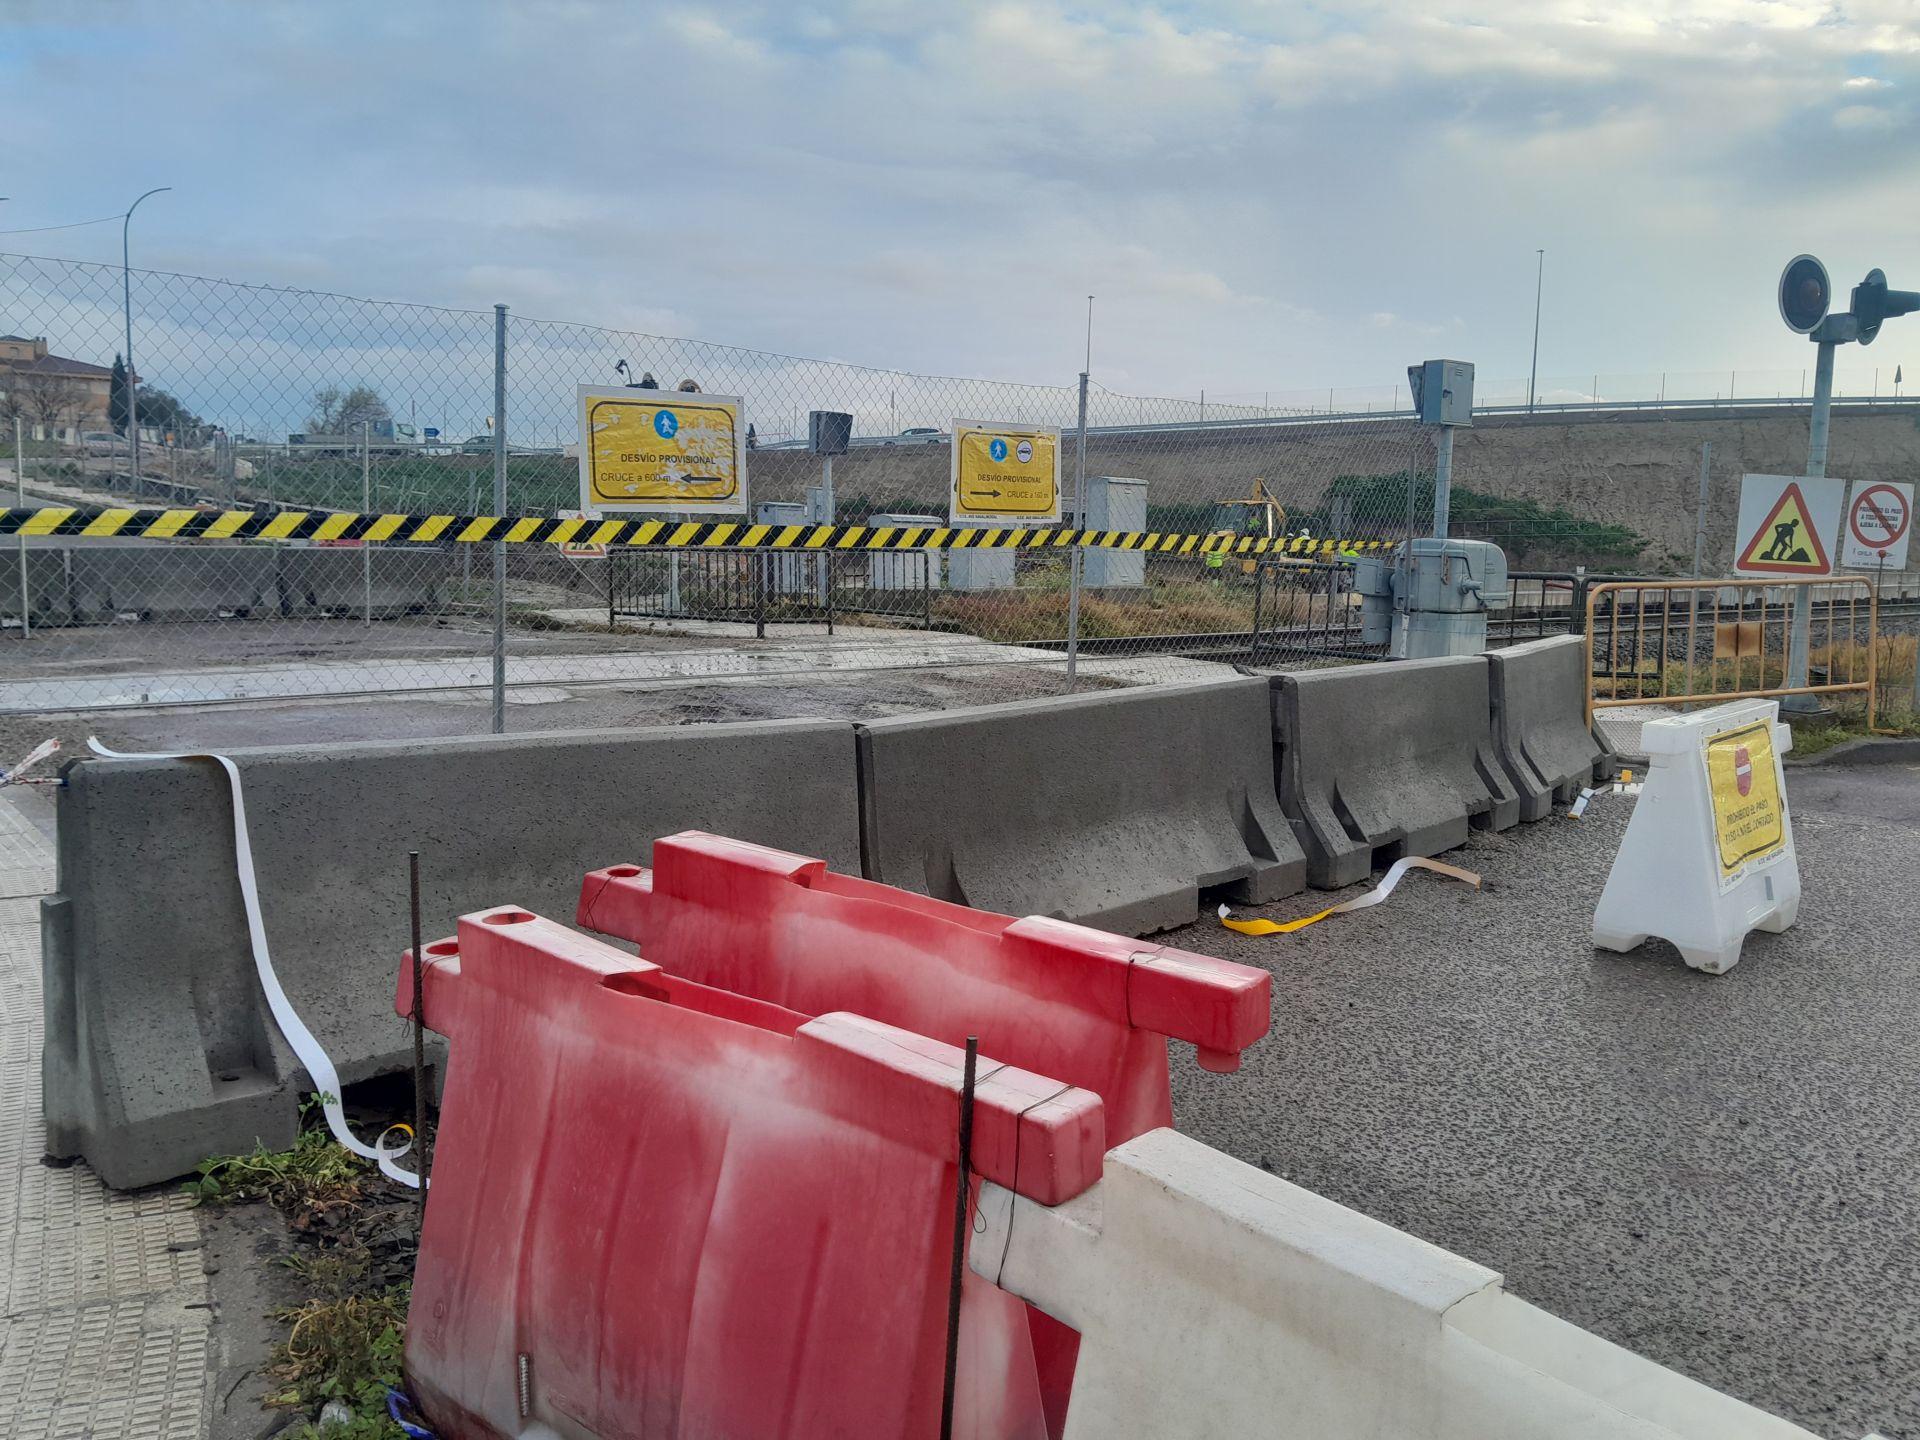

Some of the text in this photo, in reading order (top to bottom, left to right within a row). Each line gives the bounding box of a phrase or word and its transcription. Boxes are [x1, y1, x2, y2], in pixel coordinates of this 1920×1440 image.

[621, 453, 716, 465] DESVÍO PROVISIONAL
[600, 472, 635, 482] CRUCE
[644, 473, 661, 482] 600
[977, 473, 1042, 484] DESVÍO PROVISIONAL
[1007, 491, 1028, 499] CRUCE
